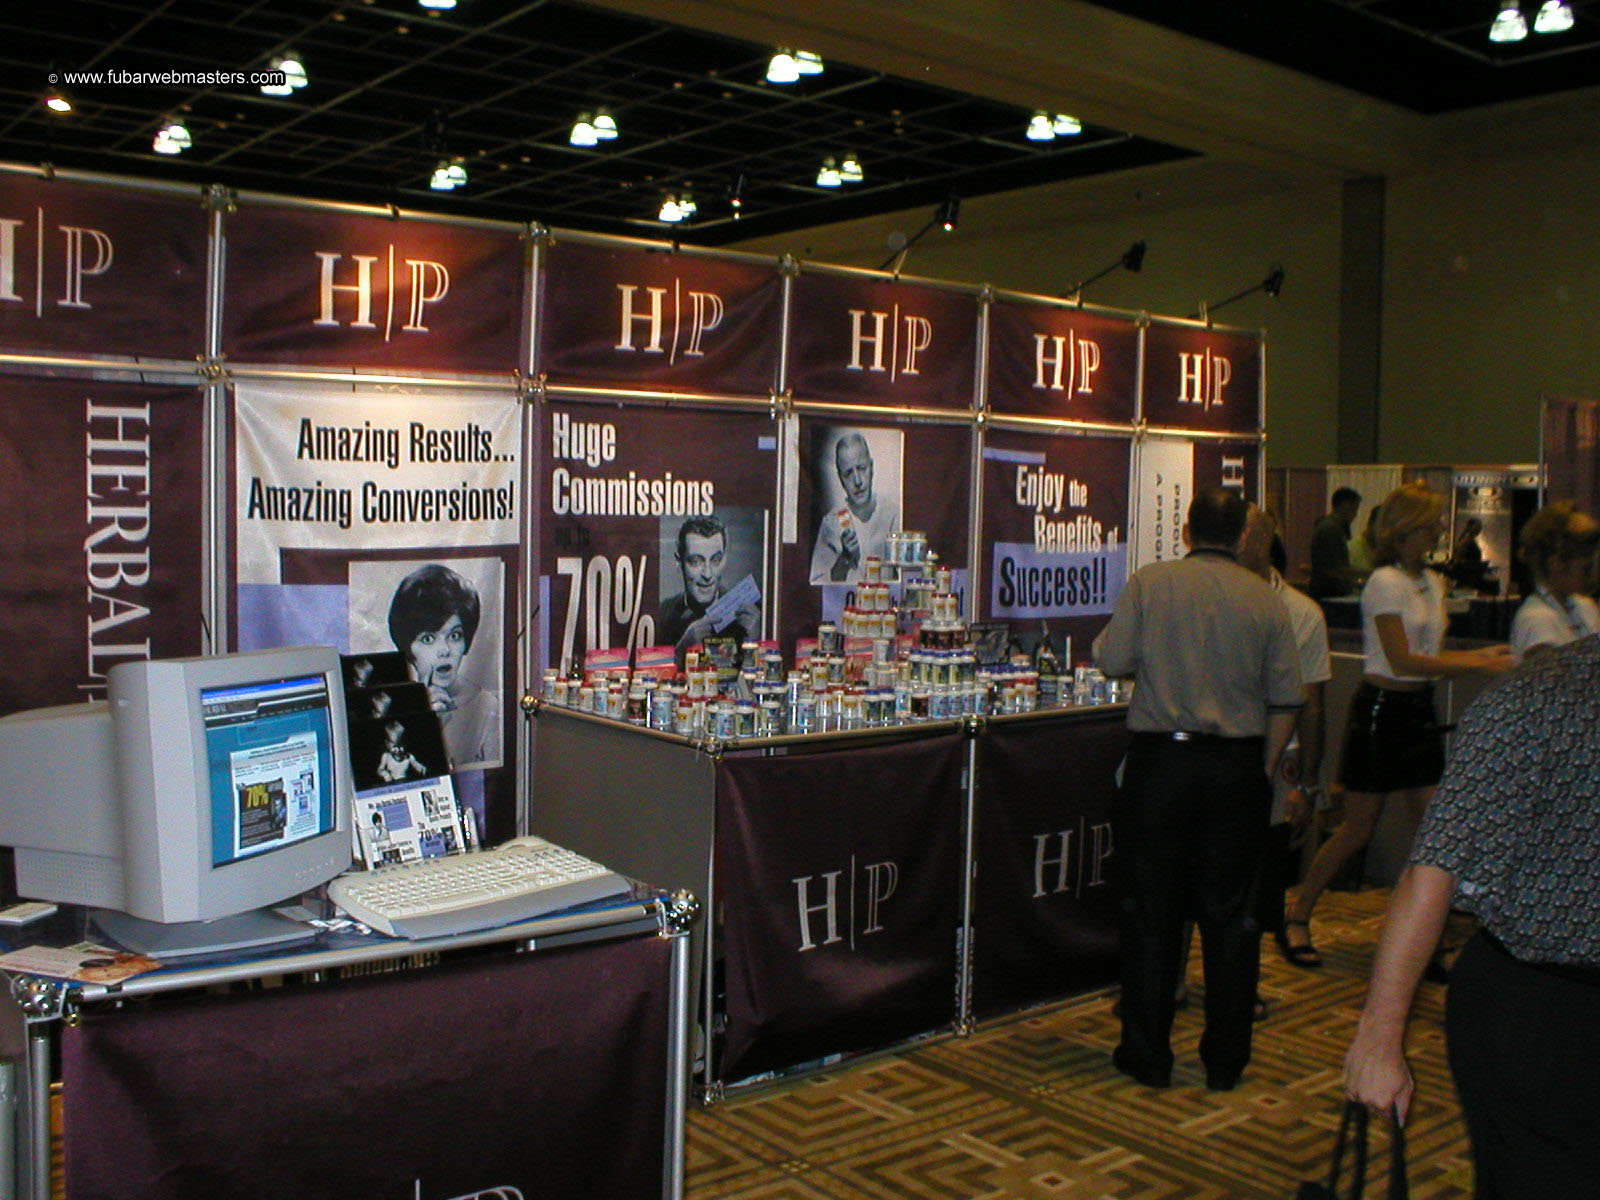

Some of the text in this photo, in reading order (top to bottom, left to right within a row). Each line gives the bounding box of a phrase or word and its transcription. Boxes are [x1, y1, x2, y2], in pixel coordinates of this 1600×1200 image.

[297, 417, 516, 469] Amazing Results...
[552, 412, 617, 467] Huge
[248, 477, 515, 529] Amazing Conversions!
[552, 468, 715, 517] Commissions
[1015, 465, 1089, 513] Enjoy the
[1034, 514, 1120, 555] Benefits of
[998, 556, 1107, 609] Success!!
[557, 554, 655, 677] 70%
